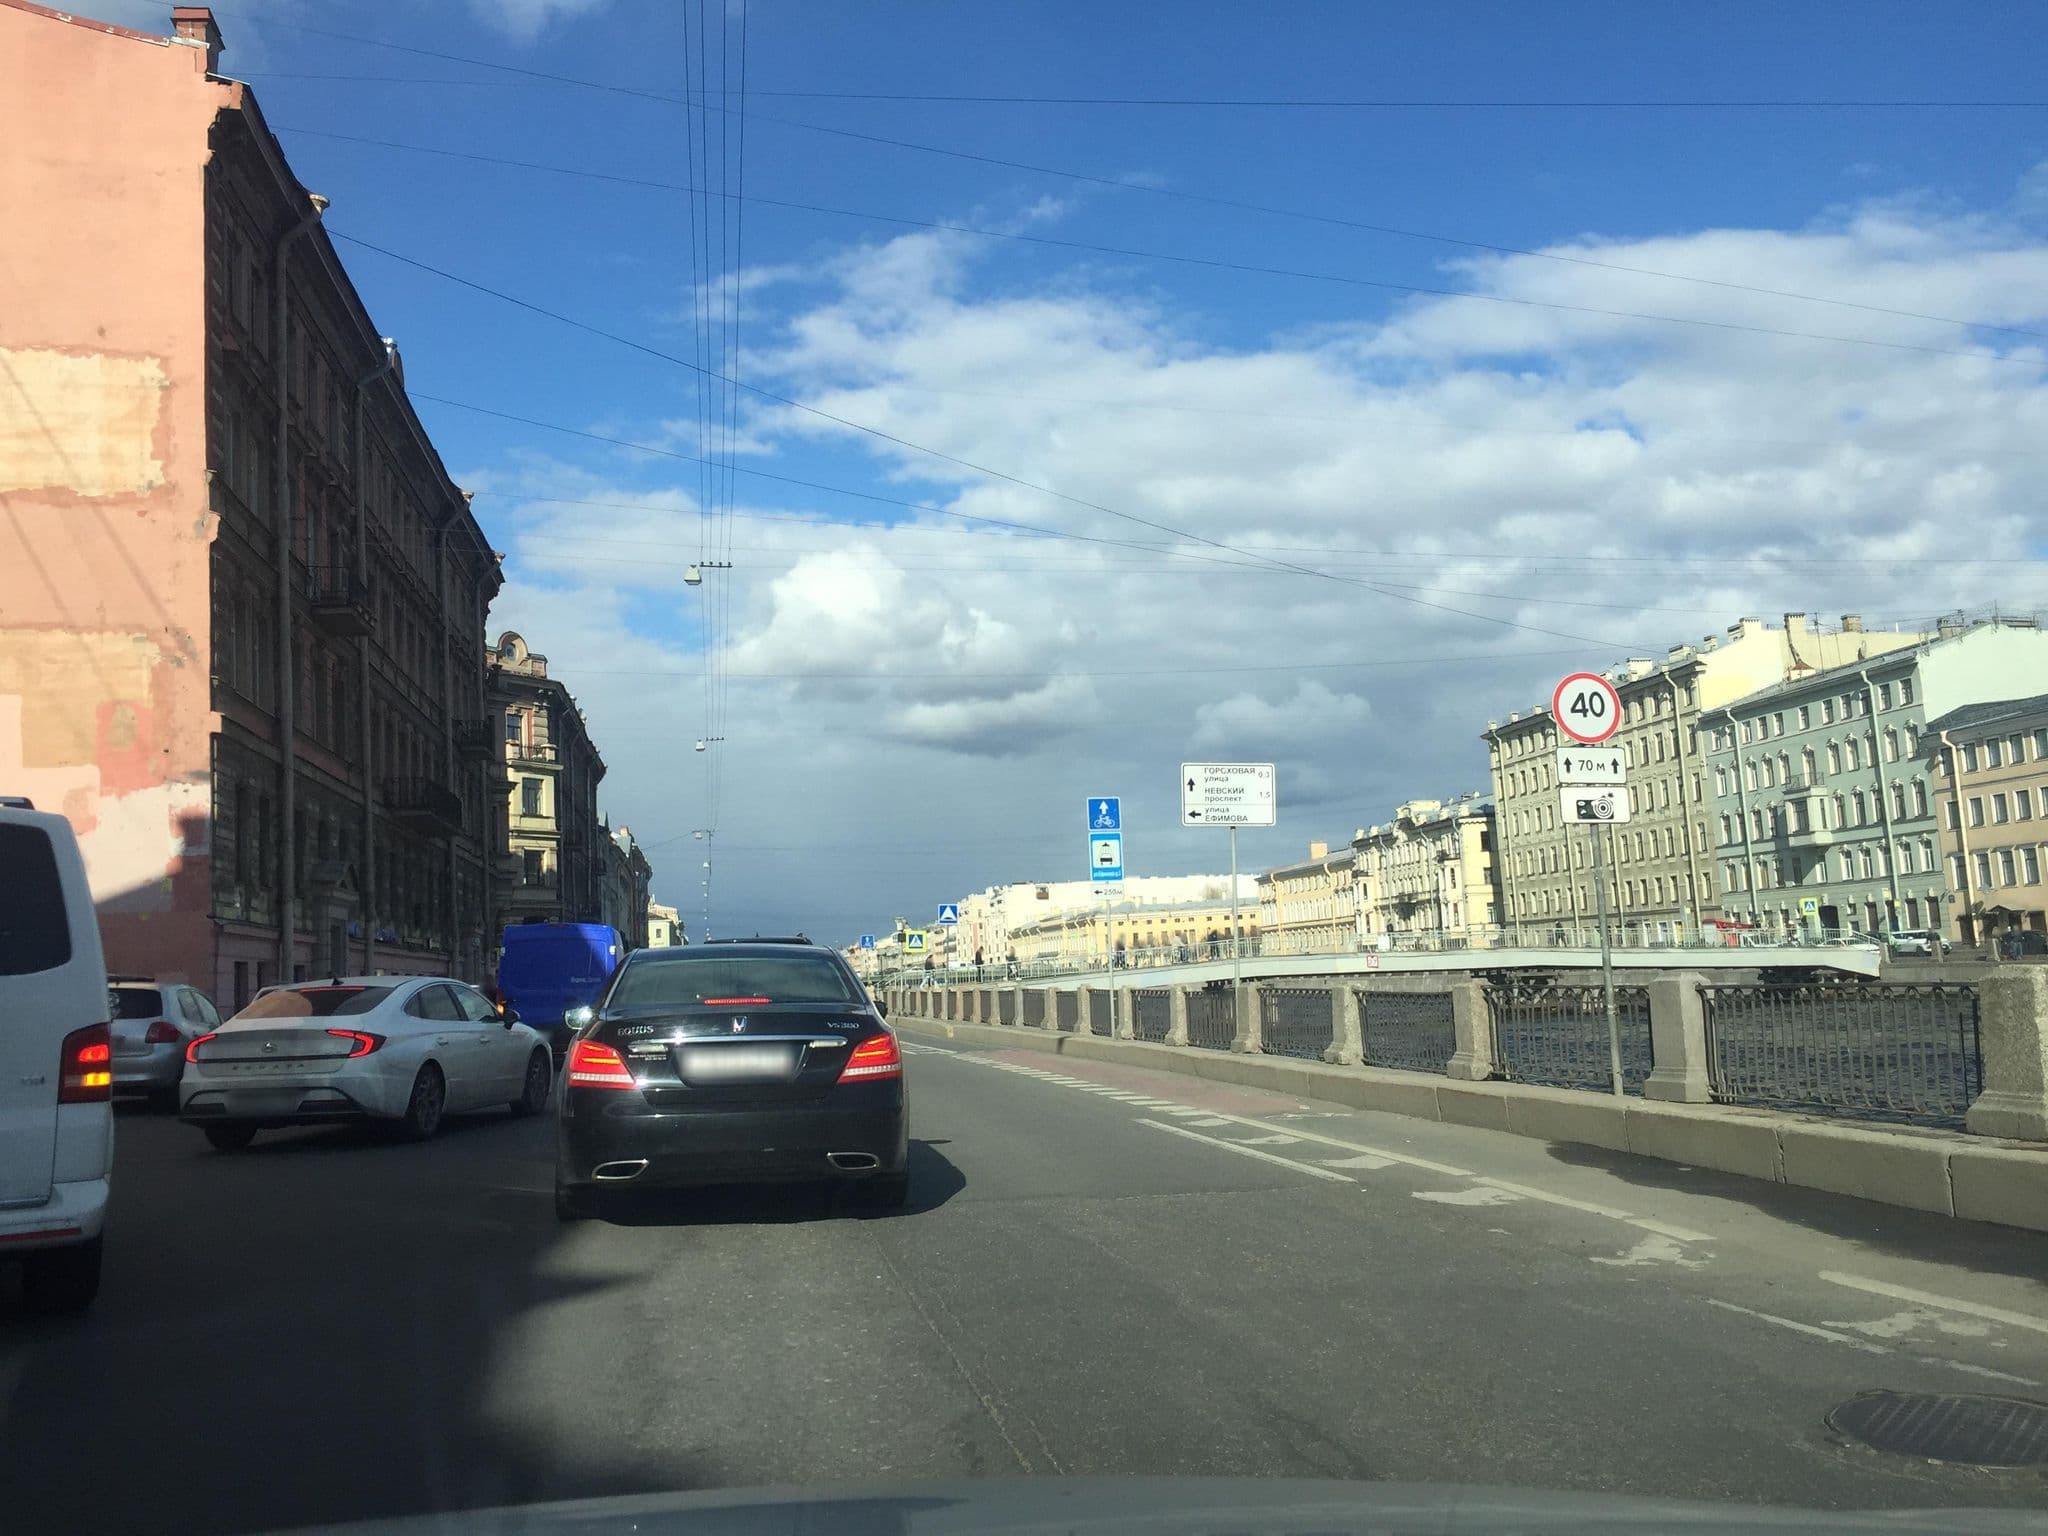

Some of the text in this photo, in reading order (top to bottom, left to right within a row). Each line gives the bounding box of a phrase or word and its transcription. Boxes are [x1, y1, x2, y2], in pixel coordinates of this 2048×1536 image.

[1570, 691, 1606, 718] 40
[1204, 767, 1256, 775] ГОРОХОВАЯ
[1578, 760, 1594, 771] 70
